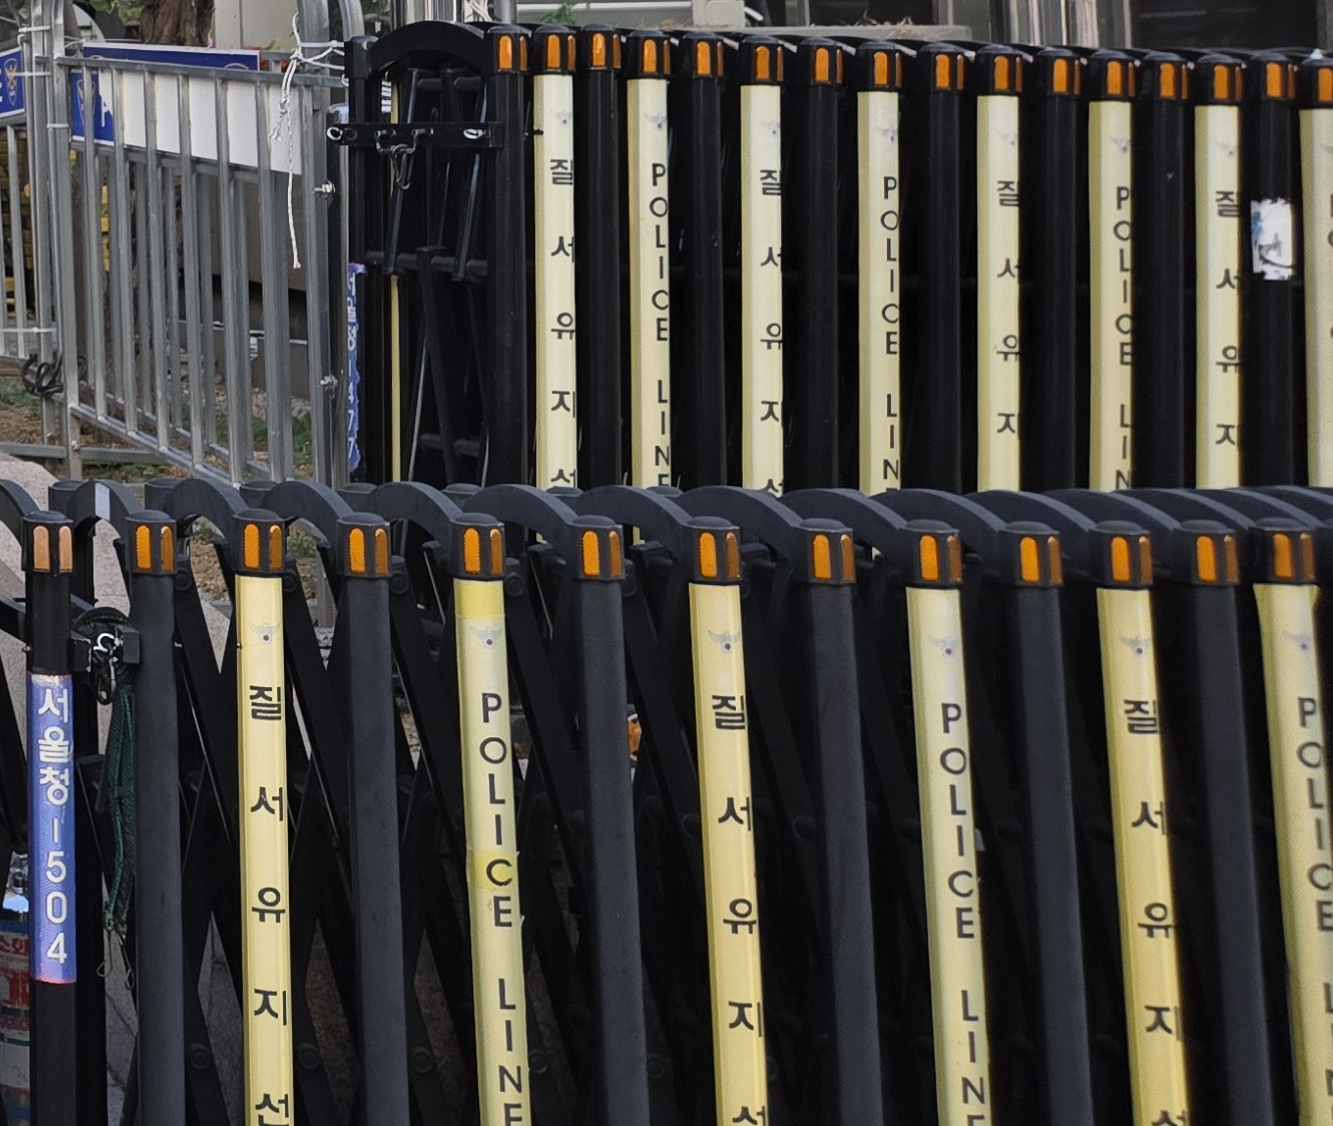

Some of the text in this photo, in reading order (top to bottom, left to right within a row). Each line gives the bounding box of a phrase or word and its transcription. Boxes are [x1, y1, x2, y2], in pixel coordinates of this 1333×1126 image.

[649, 162, 669, 342] POLICE
[880, 176, 900, 491] POLICE LIN
[1113, 186, 1133, 491] POLICE LIN
[249, 685, 291, 1126] 질서유지선
[479, 692, 524, 1126] POLICE LINE
[939, 702, 976, 939] POLICE
